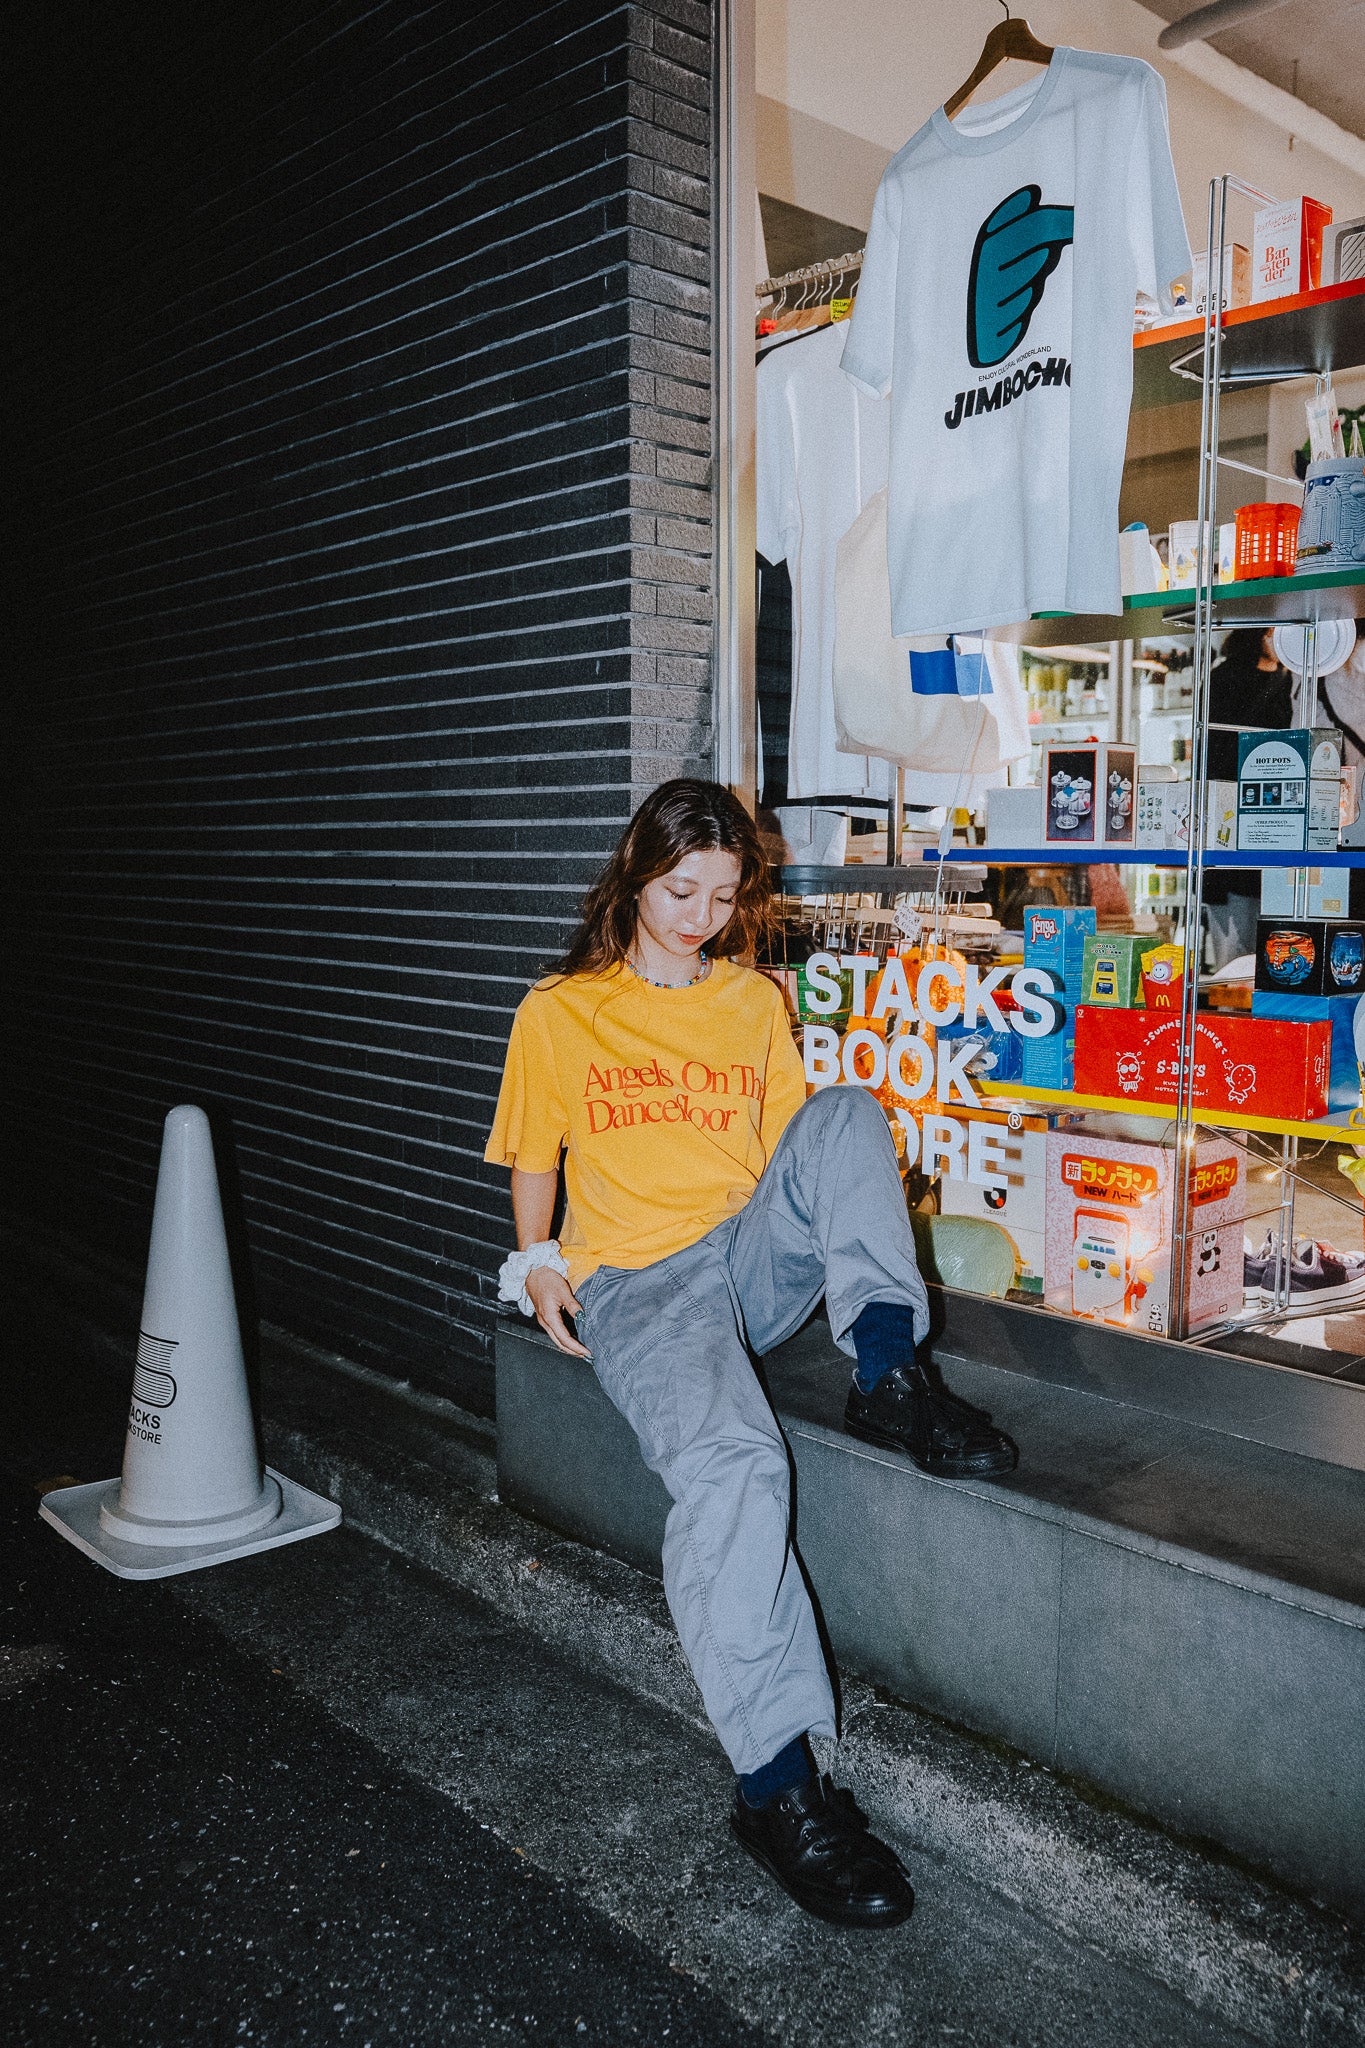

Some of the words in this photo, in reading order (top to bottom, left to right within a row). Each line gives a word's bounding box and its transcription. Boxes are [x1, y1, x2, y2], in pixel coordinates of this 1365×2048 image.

[1265, 246, 1289, 264] Bar
[1271, 256, 1291, 271] ten
[1264, 267, 1285, 283] der
[978, 371, 998, 382] ENJOY
[1030, 914, 1057, 944] Jenga
[804, 952, 1056, 1038] STACKS
[1148, 1019, 1184, 1041] SUMME
[1193, 1023, 1223, 1049] RINCE
[583, 1058, 674, 1099] Angels
[681, 1060, 731, 1095] On
[803, 1024, 983, 1109] BOOK
[583, 1093, 738, 1135] Dancefloor
[888, 1107, 1008, 1190] ORE
[1084, 1185, 1108, 1198] NEW
[130, 1405, 161, 1430] ACKS
[127, 1423, 162, 1445] KSTORE
